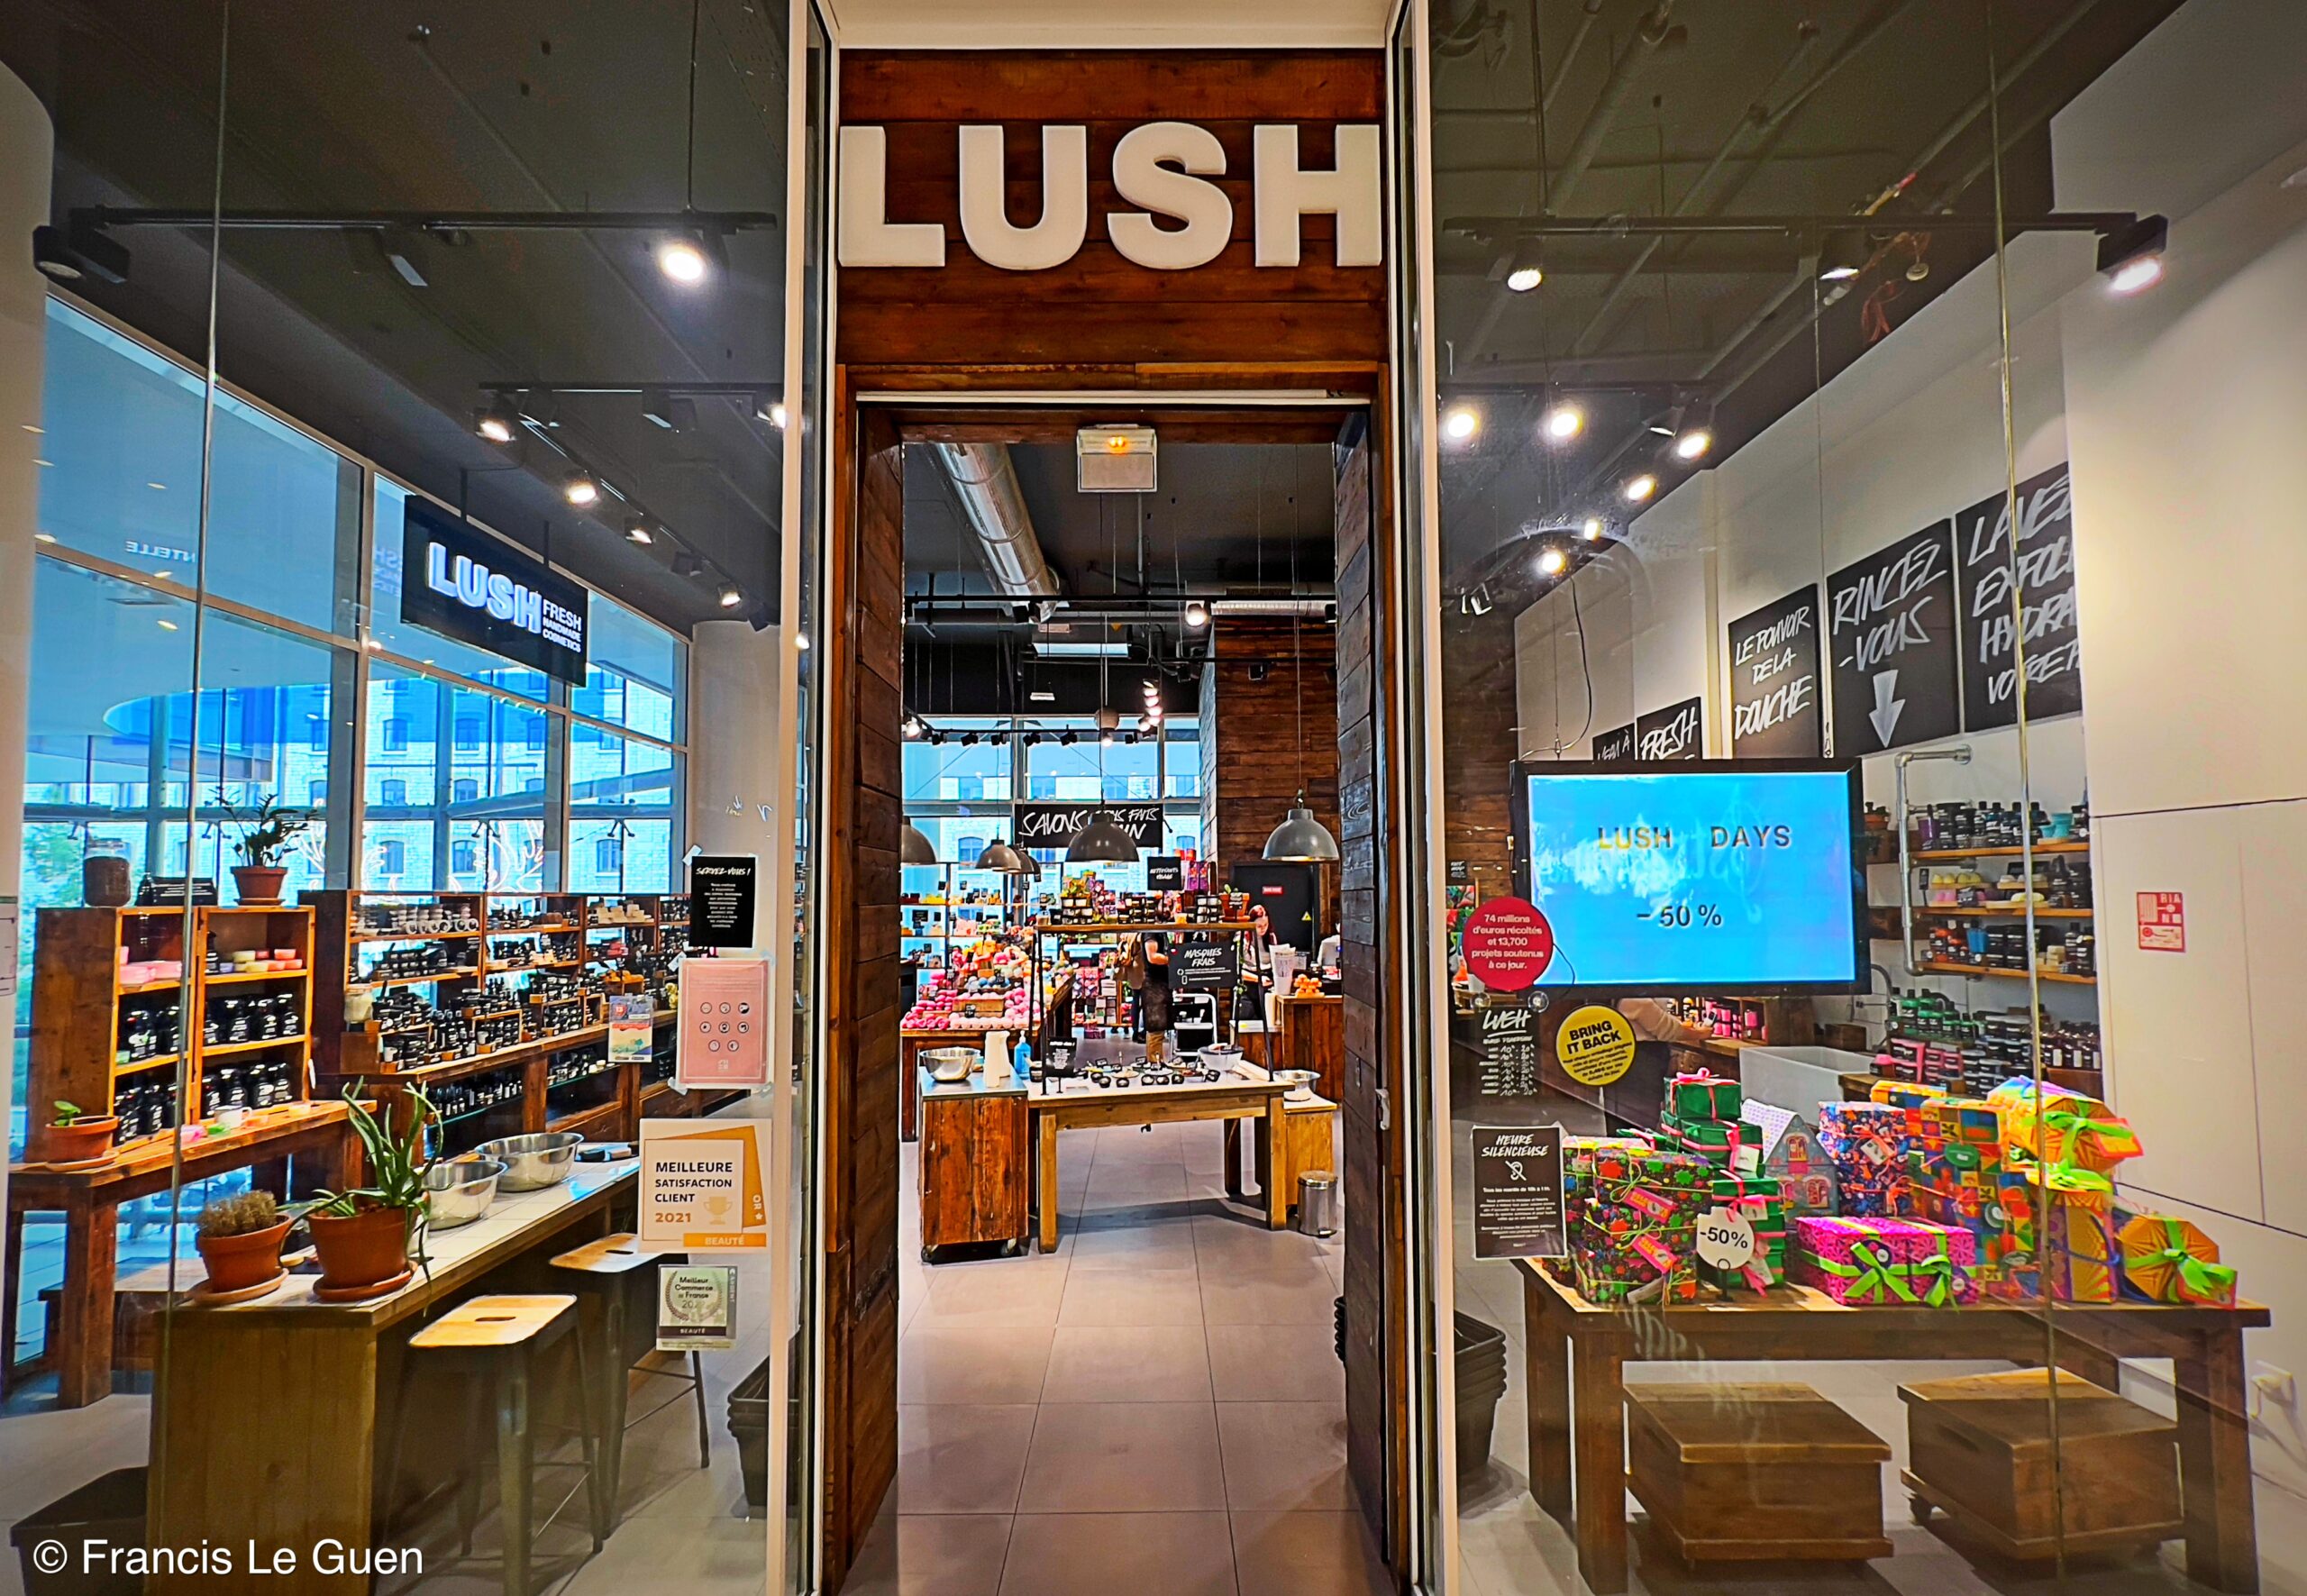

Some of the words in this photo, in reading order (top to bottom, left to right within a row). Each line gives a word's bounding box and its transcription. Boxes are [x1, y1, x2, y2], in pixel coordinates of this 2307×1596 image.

[838, 122, 1382, 269] LUSH
[428, 542, 543, 634] LUSH
[1833, 539, 1947, 635] RINCEZ
[543, 598, 582, 632] FRESH
[543, 616, 581, 643] HANDMADE
[1735, 634, 1755, 667] LE
[1755, 606, 1811, 654] POUVOIR
[543, 628, 581, 653] COSMETICS
[1752, 657, 1774, 686] DE
[1772, 646, 1798, 675] LA
[1734, 675, 1813, 740] DOUCHE
[1018, 810, 1088, 837] SAVONS
[1128, 807, 1160, 822] FAITS
[1598, 826, 1672, 849] LUSH
[1710, 825, 1791, 848] DAYS
[1484, 914, 1496, 923] 74
[1497, 915, 1530, 923] millions
[1473, 926, 1506, 935] d'euros
[1506, 926, 1543, 935] récoltés
[1487, 938, 1497, 946] et
[1498, 937, 1528, 947] 13,700
[1183, 947, 1222, 960] MASQUES
[1472, 949, 1502, 959] projets
[1503, 950, 1544, 958] soutenus
[1191, 958, 1217, 967] FRAIS
[1488, 960, 1495, 969] à
[1507, 960, 1527, 971] jour.
[1482, 1008, 1532, 1030] LUSH
[1569, 1020, 1613, 1041] BRING
[1566, 1042, 1580, 1054] IT
[1582, 1030, 1622, 1050] BACK
[1496, 1134, 1534, 1145] HEURE
[1481, 1145, 1549, 1157] SILENCIEUSE
[655, 1162, 733, 1172] MEILLEURE
[655, 1179, 732, 1188] SATISFACTION
[655, 1193, 695, 1203] CLIENT
[752, 1194, 762, 1210] OR
[655, 1212, 691, 1223] 2021
[705, 1234, 745, 1245] BEAUTÉ
[1700, 1227, 1748, 1249] -50%
[674, 1283, 714, 1291] Commerce
